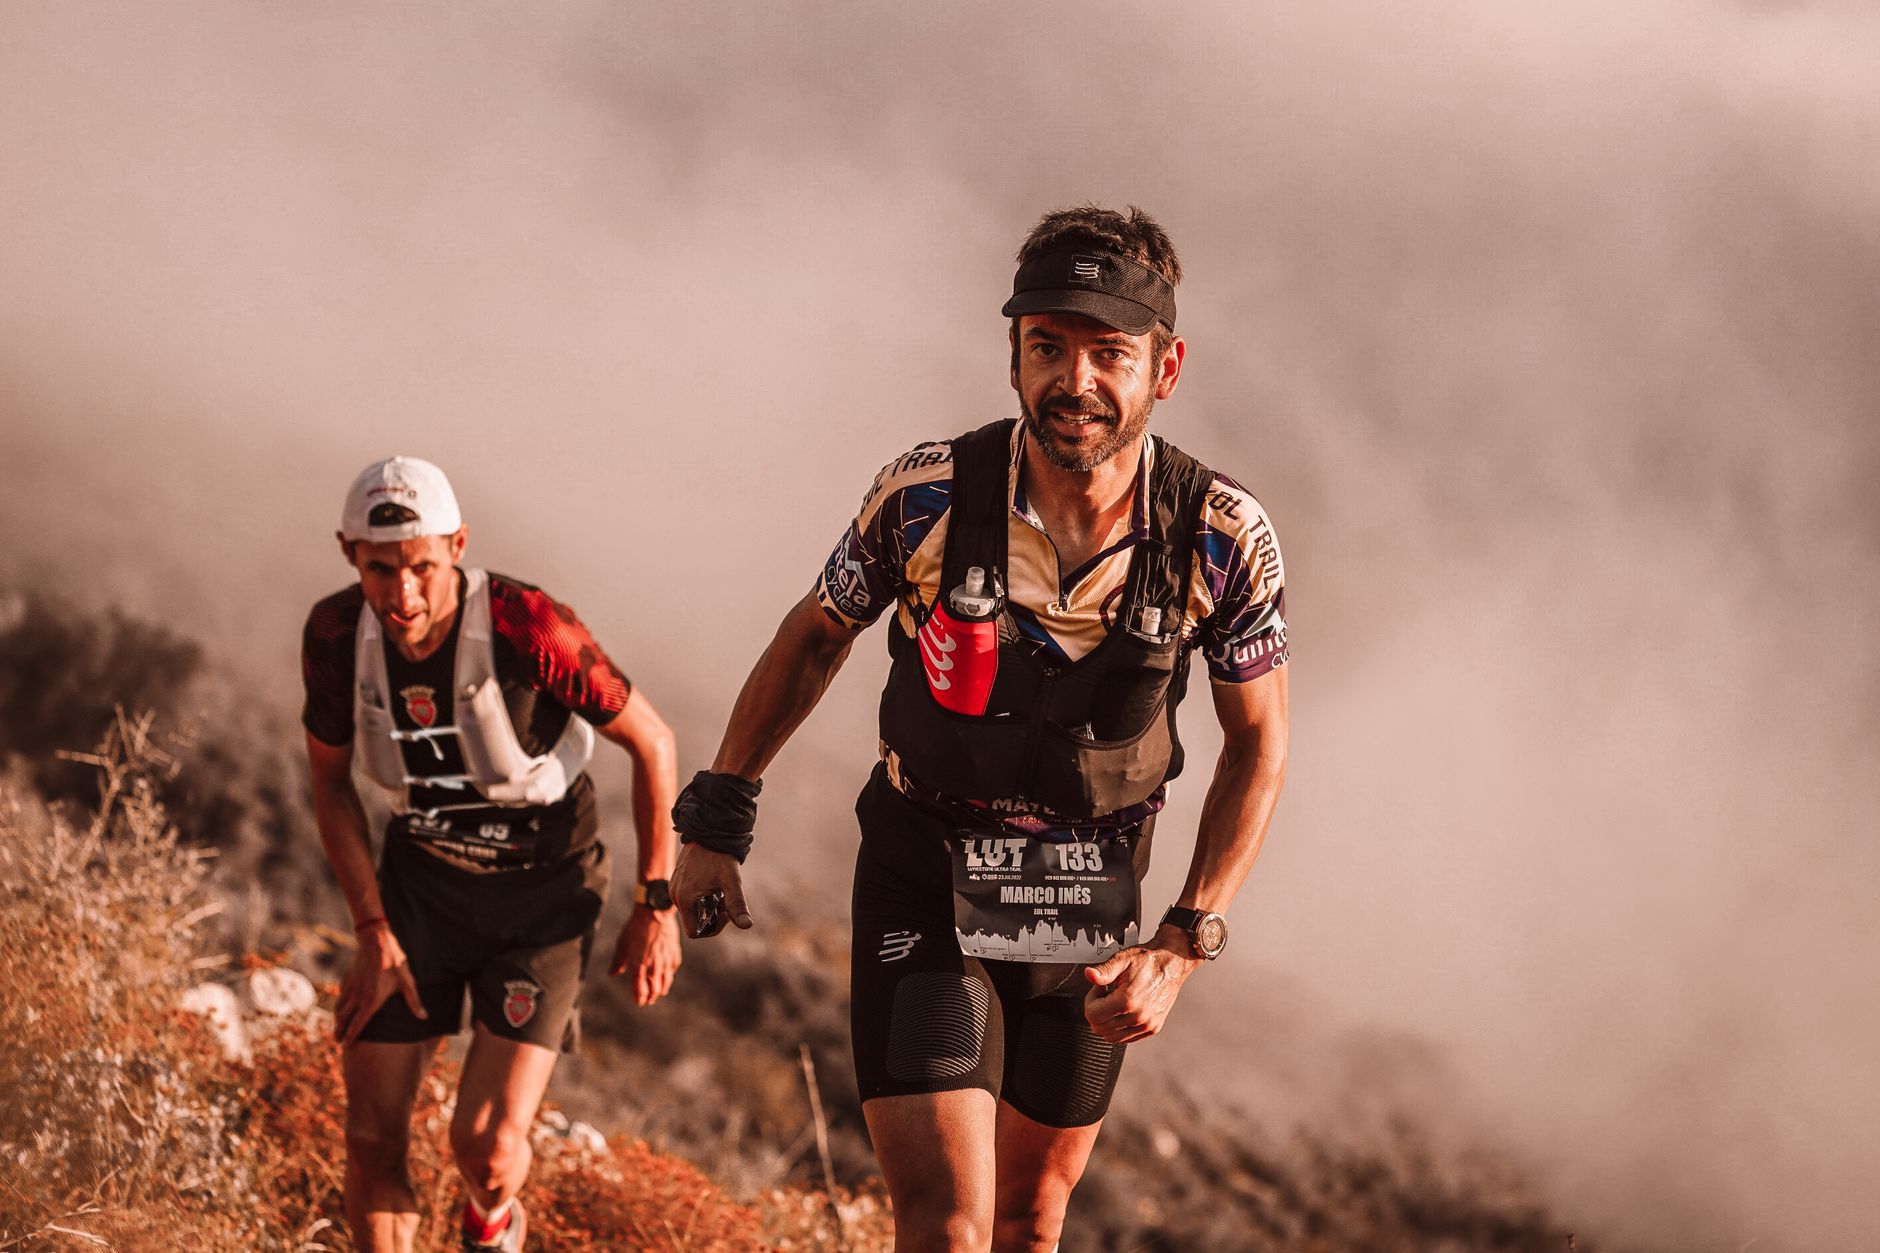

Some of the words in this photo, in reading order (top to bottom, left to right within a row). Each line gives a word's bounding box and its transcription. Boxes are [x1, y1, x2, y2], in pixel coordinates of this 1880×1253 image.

[892, 450, 953, 477] TRAI
[1205, 490, 1242, 521] OL
[1249, 515, 1280, 590] TRAIL
[964, 838, 1028, 867] LUT
[1055, 842, 1103, 871] 133
[1000, 885, 1055, 904] MARCO
[1058, 884, 1091, 905] INÊS
[1044, 908, 1059, 916] TRAIL
